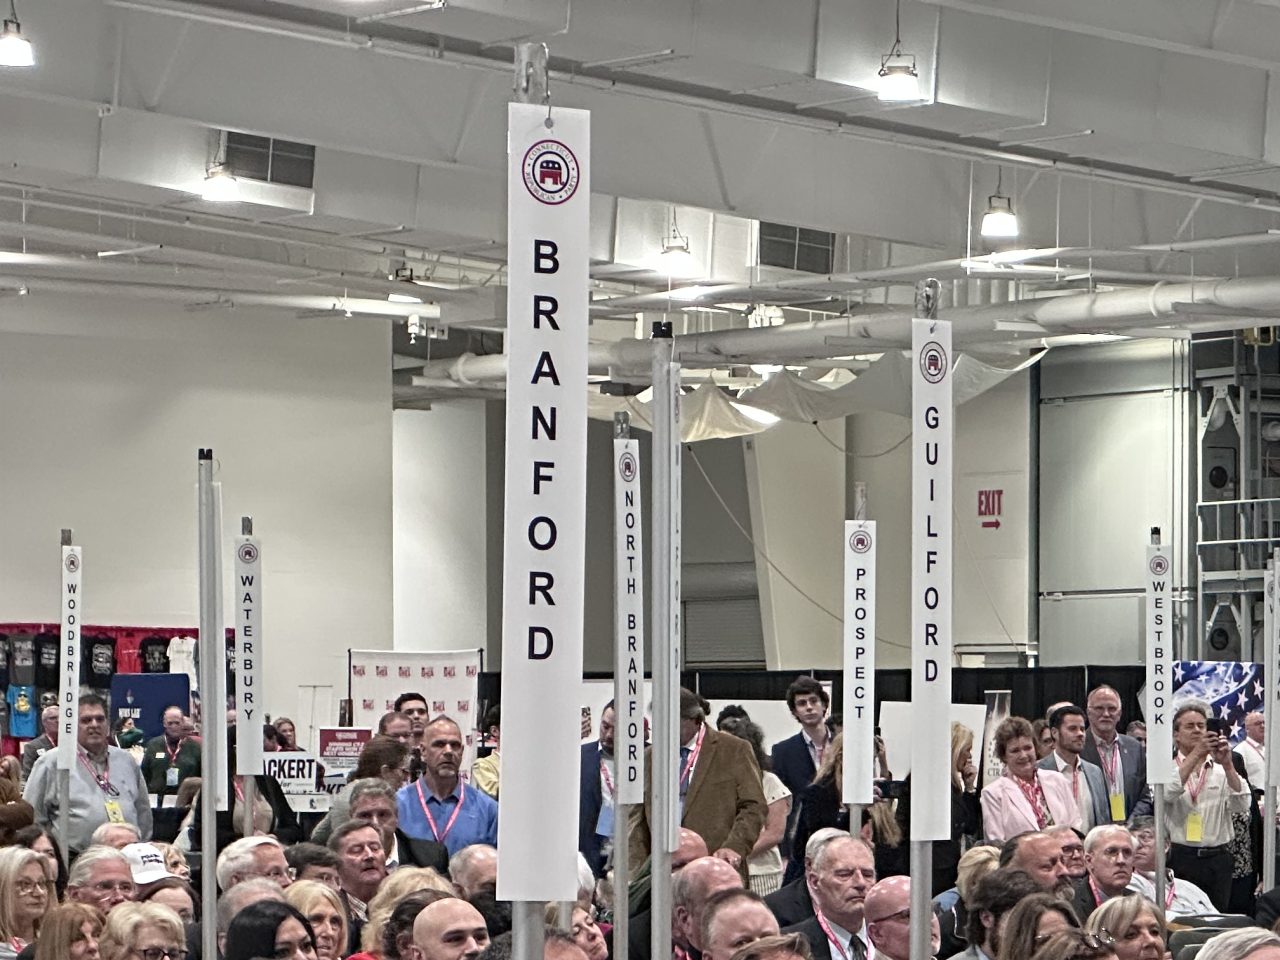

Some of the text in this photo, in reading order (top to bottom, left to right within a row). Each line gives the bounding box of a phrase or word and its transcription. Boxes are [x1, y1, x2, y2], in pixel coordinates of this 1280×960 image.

[527, 239, 561, 661] BRANFORD
[978, 489, 1004, 516] EXIT
[924, 406, 940, 682] GUILFORD
[65, 583, 78, 734] WOODBRIDGE
[240, 575, 254, 721] WATERBURY
[625, 490, 638, 783] NORTH BRANFORD
[854, 567, 867, 719] PROSPECT
[1152, 581, 1166, 725] WESTBROOK
